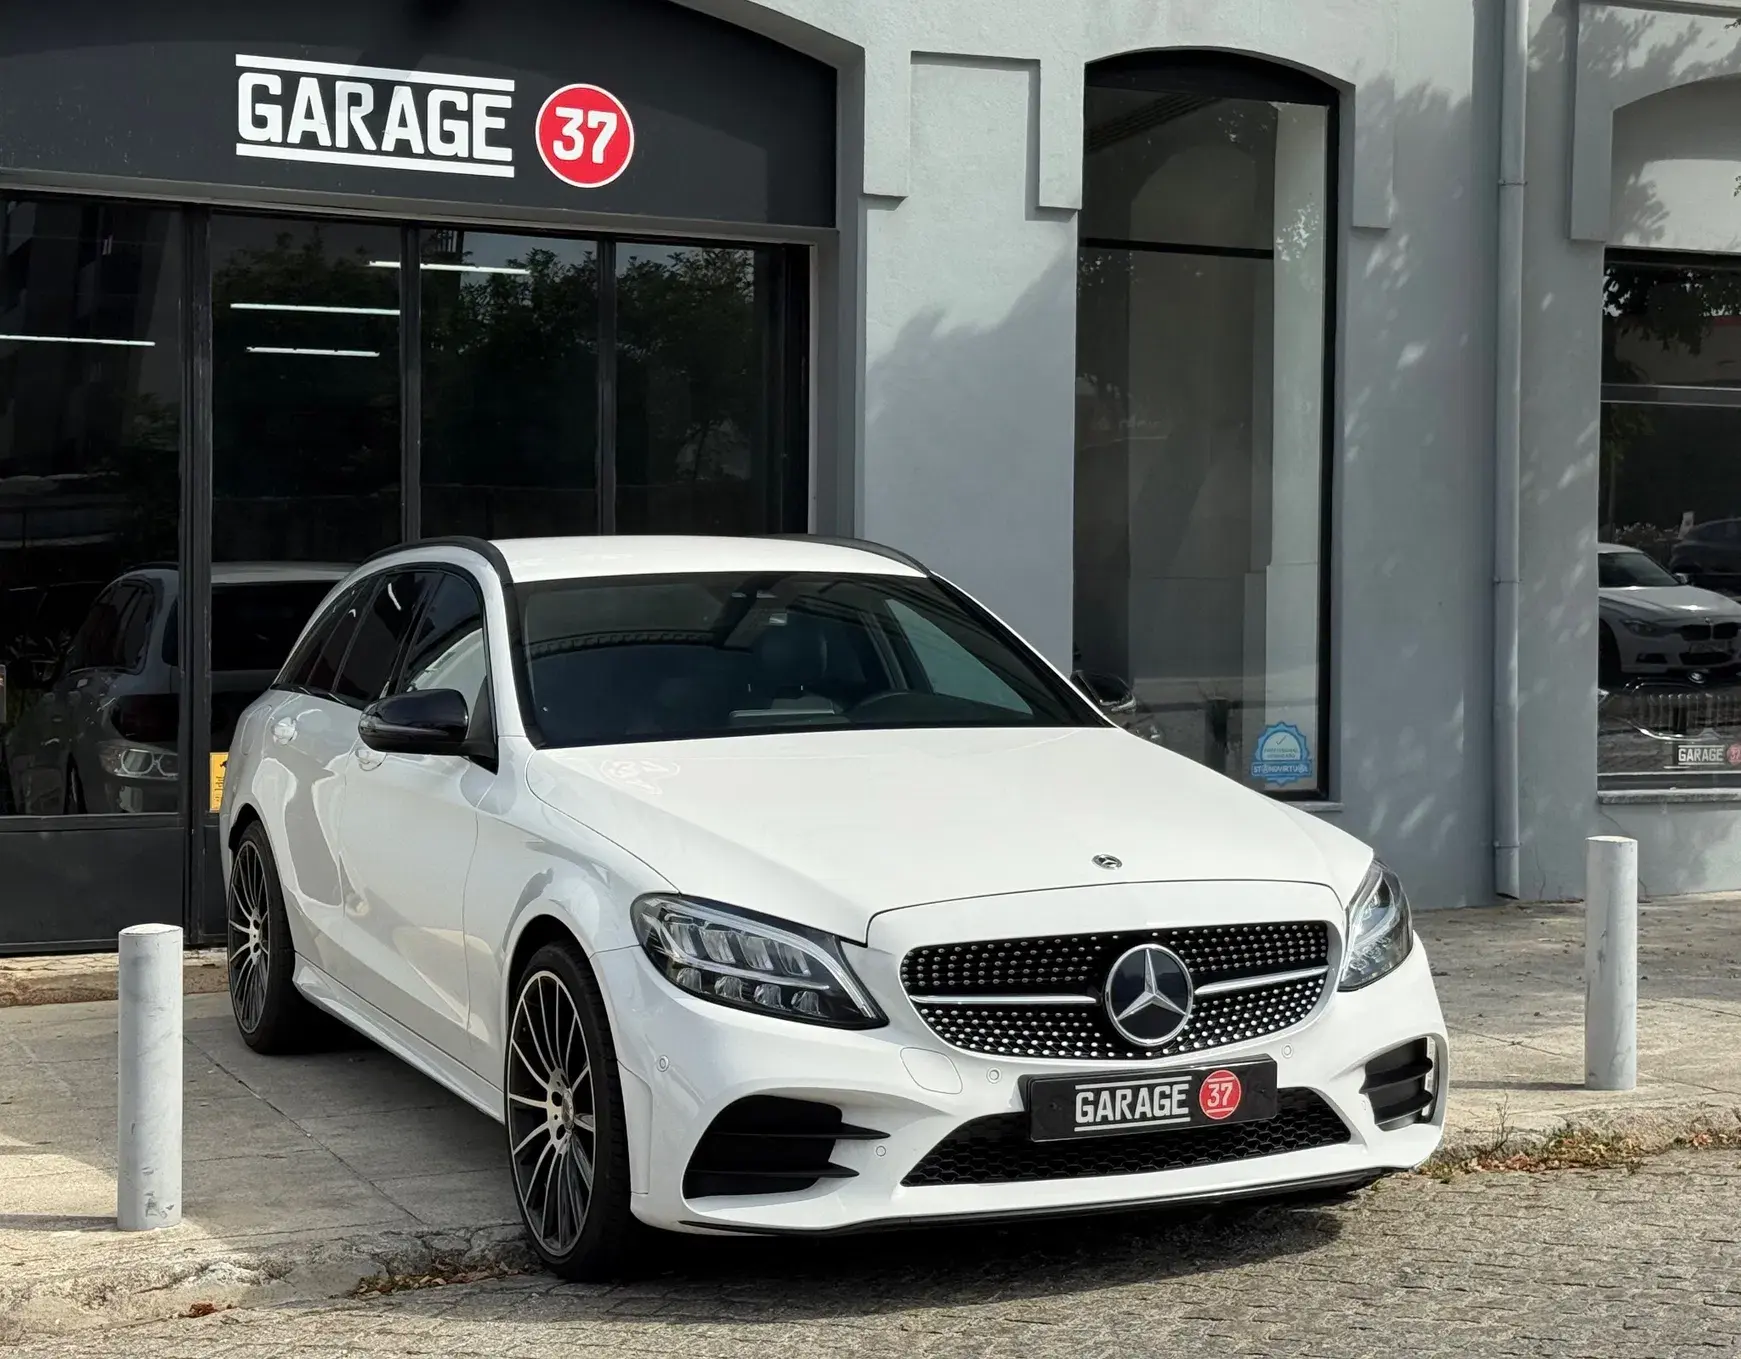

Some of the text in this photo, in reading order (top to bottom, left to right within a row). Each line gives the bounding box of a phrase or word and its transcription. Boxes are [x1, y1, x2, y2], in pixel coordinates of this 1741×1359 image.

[238, 72, 618, 164] GARAGE 37
[1678, 748, 1724, 762] GARAGE
[1075, 1083, 1233, 1123] GARAGE 37
